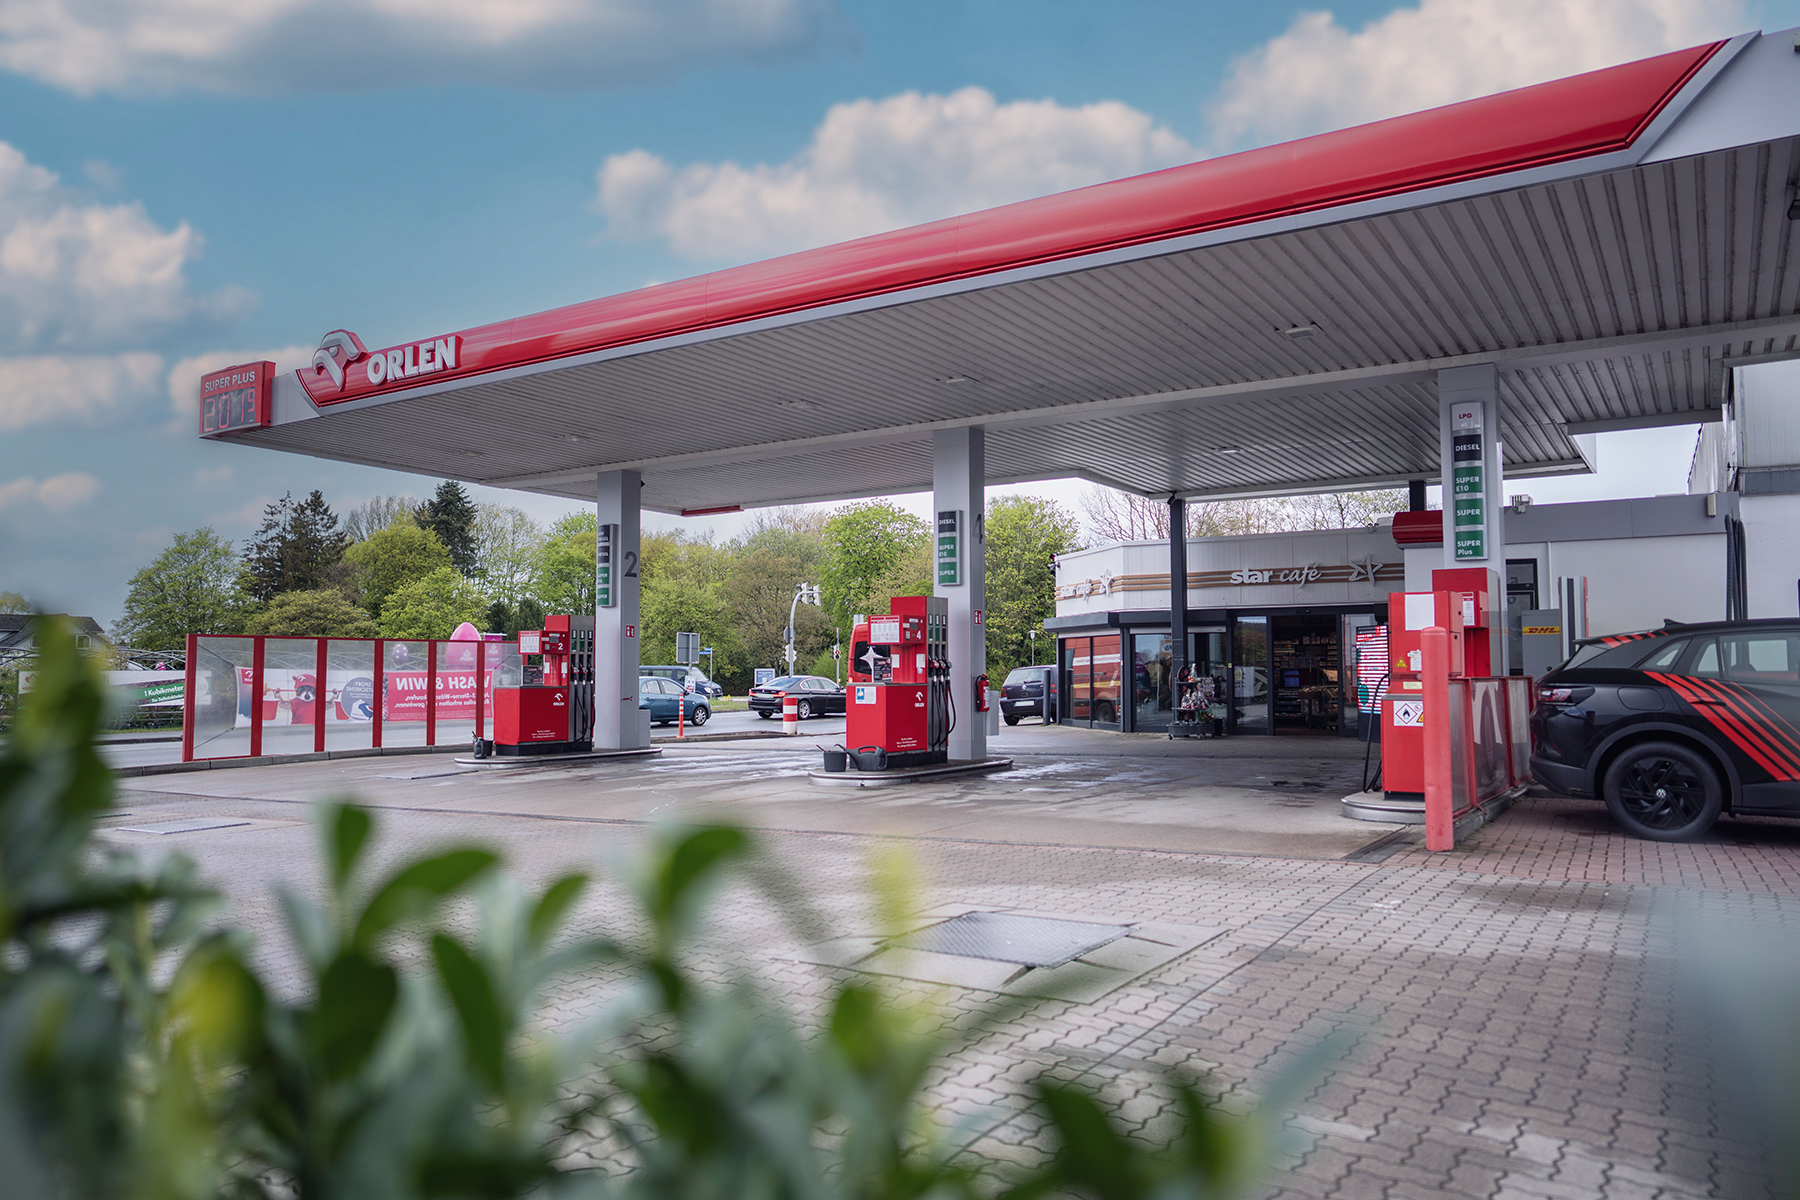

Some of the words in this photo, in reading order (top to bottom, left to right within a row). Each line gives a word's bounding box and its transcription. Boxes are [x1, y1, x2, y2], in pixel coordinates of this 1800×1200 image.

[367, 336, 456, 385] ORLEN
[204, 376, 230, 393] SUPER
[231, 370, 256, 386] PLUS
[1458, 412, 1473, 420] LPG
[1455, 444, 1481, 452] DIESEL
[1455, 476, 1480, 484] SUPER
[972, 513, 983, 544] 4
[1457, 540, 1482, 548] SUPER
[1457, 548, 1473, 556] Plus
[624, 551, 637, 577] 2
[1230, 567, 1274, 586] star
[1279, 561, 1322, 588] café
[916, 630, 922, 640] 4
[557, 642, 564, 651] 2
[147, 685, 184, 697] Kubikmeter
